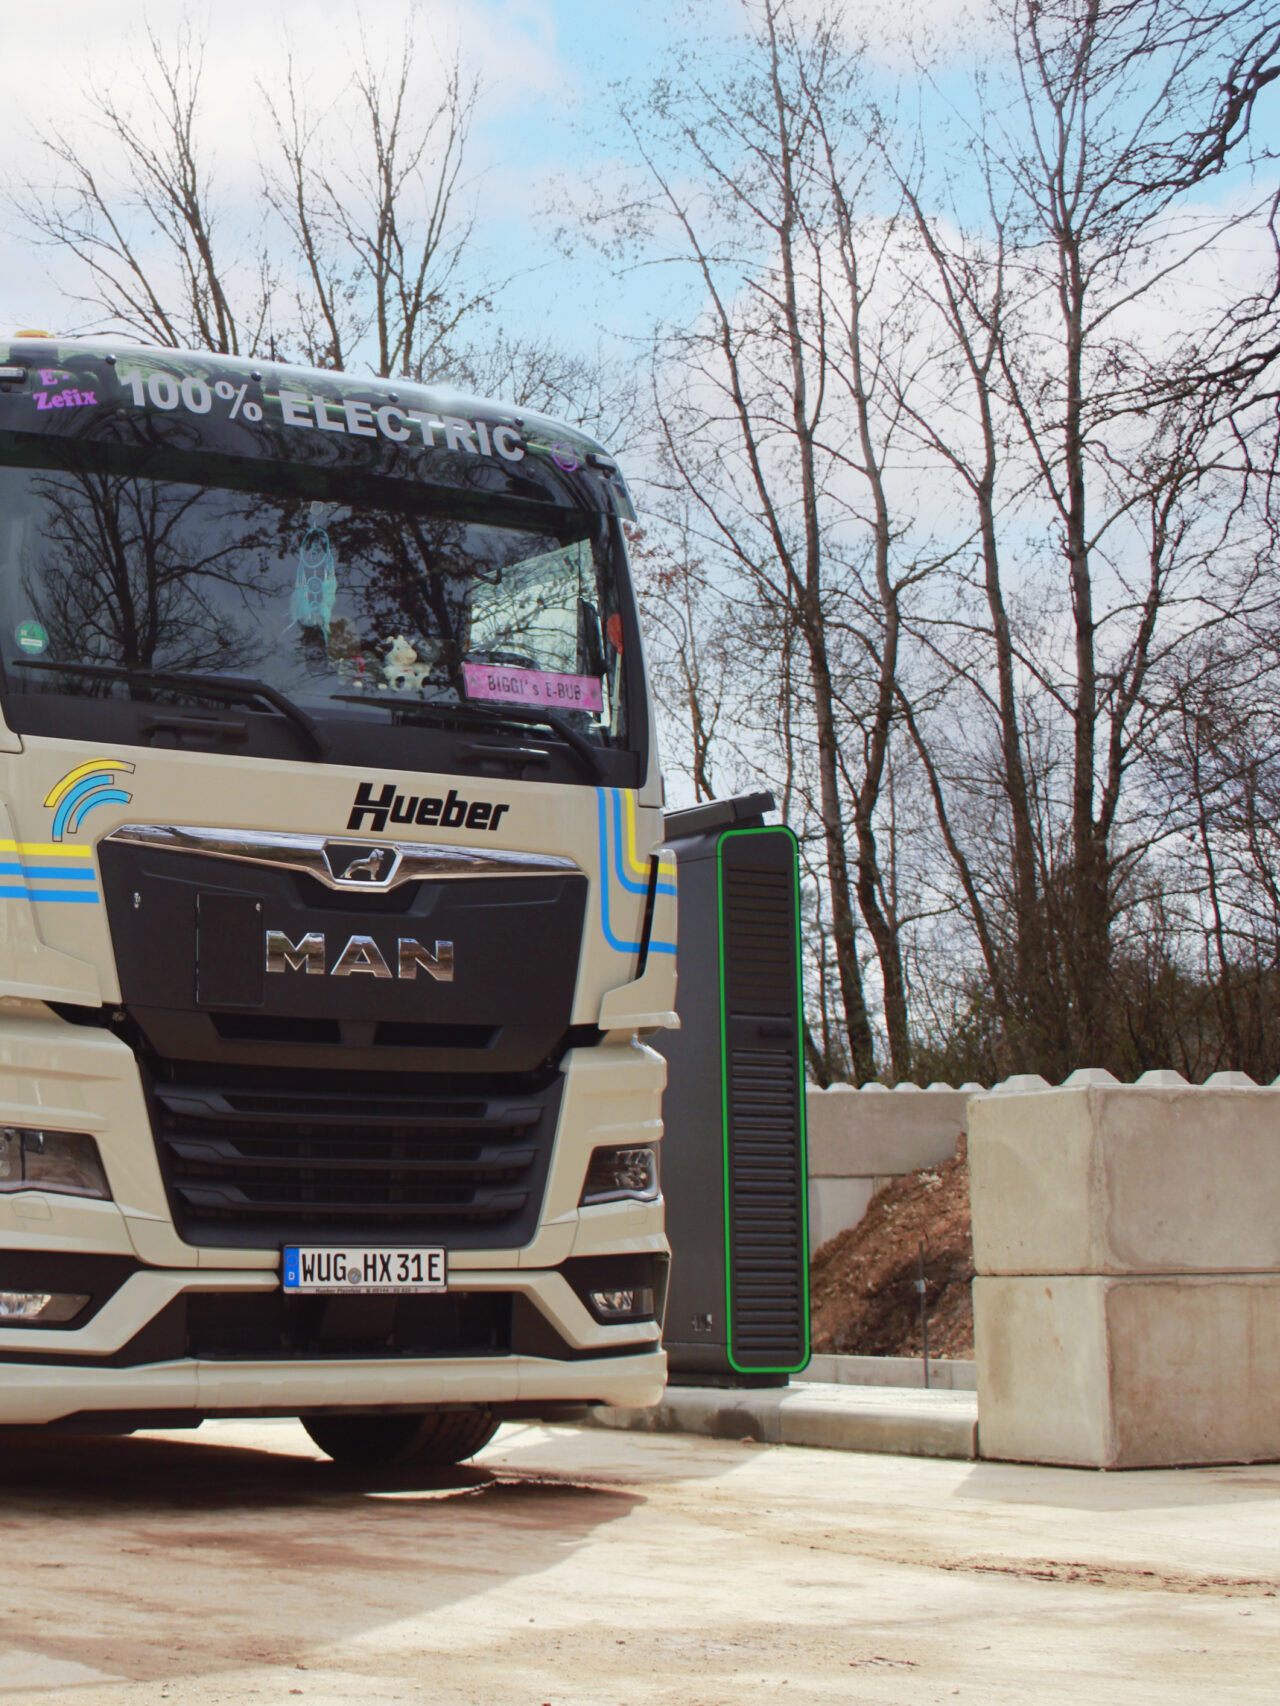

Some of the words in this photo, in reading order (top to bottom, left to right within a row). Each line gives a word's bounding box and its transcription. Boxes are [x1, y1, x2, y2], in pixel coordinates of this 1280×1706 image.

[33, 389, 98, 410] Zefix
[121, 370, 263, 422] 100%
[278, 390, 526, 461] ELECTRIC
[346, 782, 510, 831] Hueber
[266, 930, 455, 981] MAN
[288, 1271, 296, 1281] D
[301, 1253, 347, 1282] WUG
